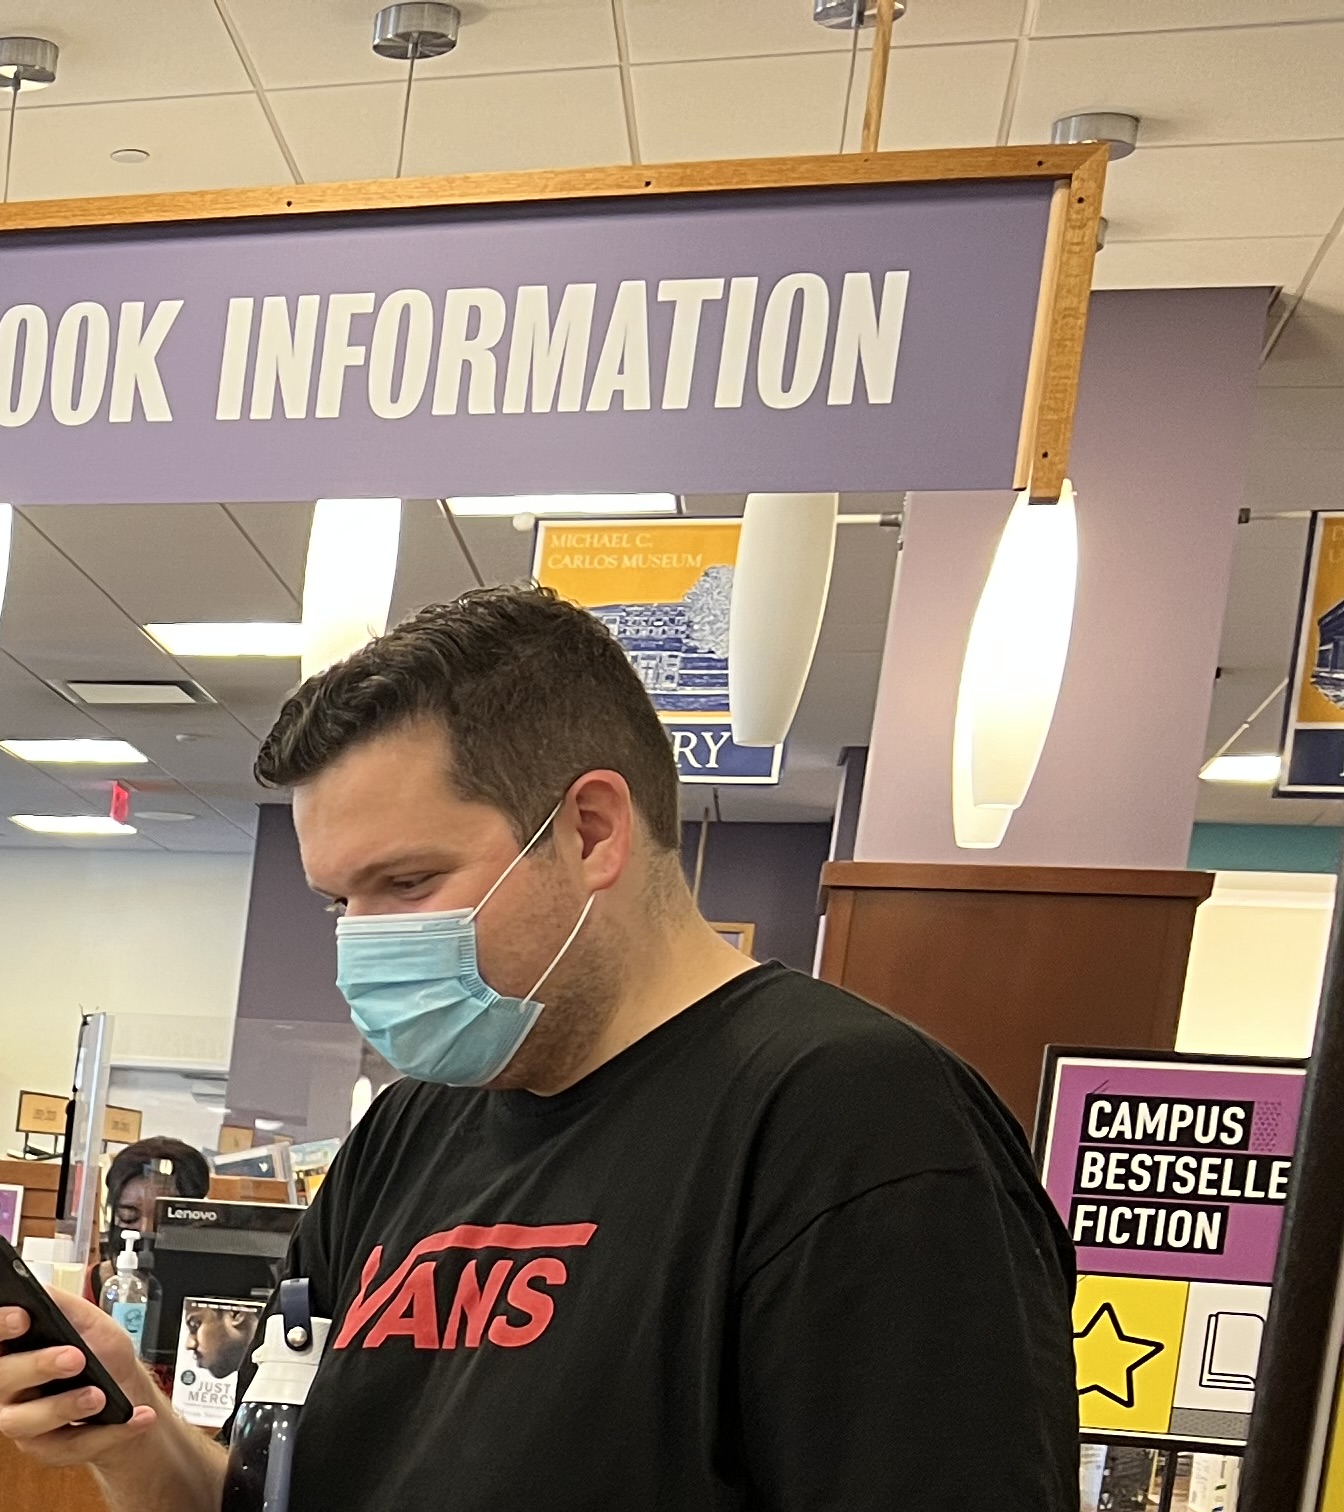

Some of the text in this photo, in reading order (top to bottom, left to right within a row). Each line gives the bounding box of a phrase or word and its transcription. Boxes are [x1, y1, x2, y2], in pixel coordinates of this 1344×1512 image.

[214, 270, 910, 422] INFORMATION
[550, 532, 632, 548] MICHAEL
[547, 552, 703, 569] CARLOS MUSEUM
[1087, 1099, 1246, 1145] CAMPUS
[167, 1206, 217, 1221] Lenovo
[1073, 1204, 1224, 1250] FICTION
[333, 1223, 598, 1349] VANS
[198, 1380, 232, 1394] JUST
